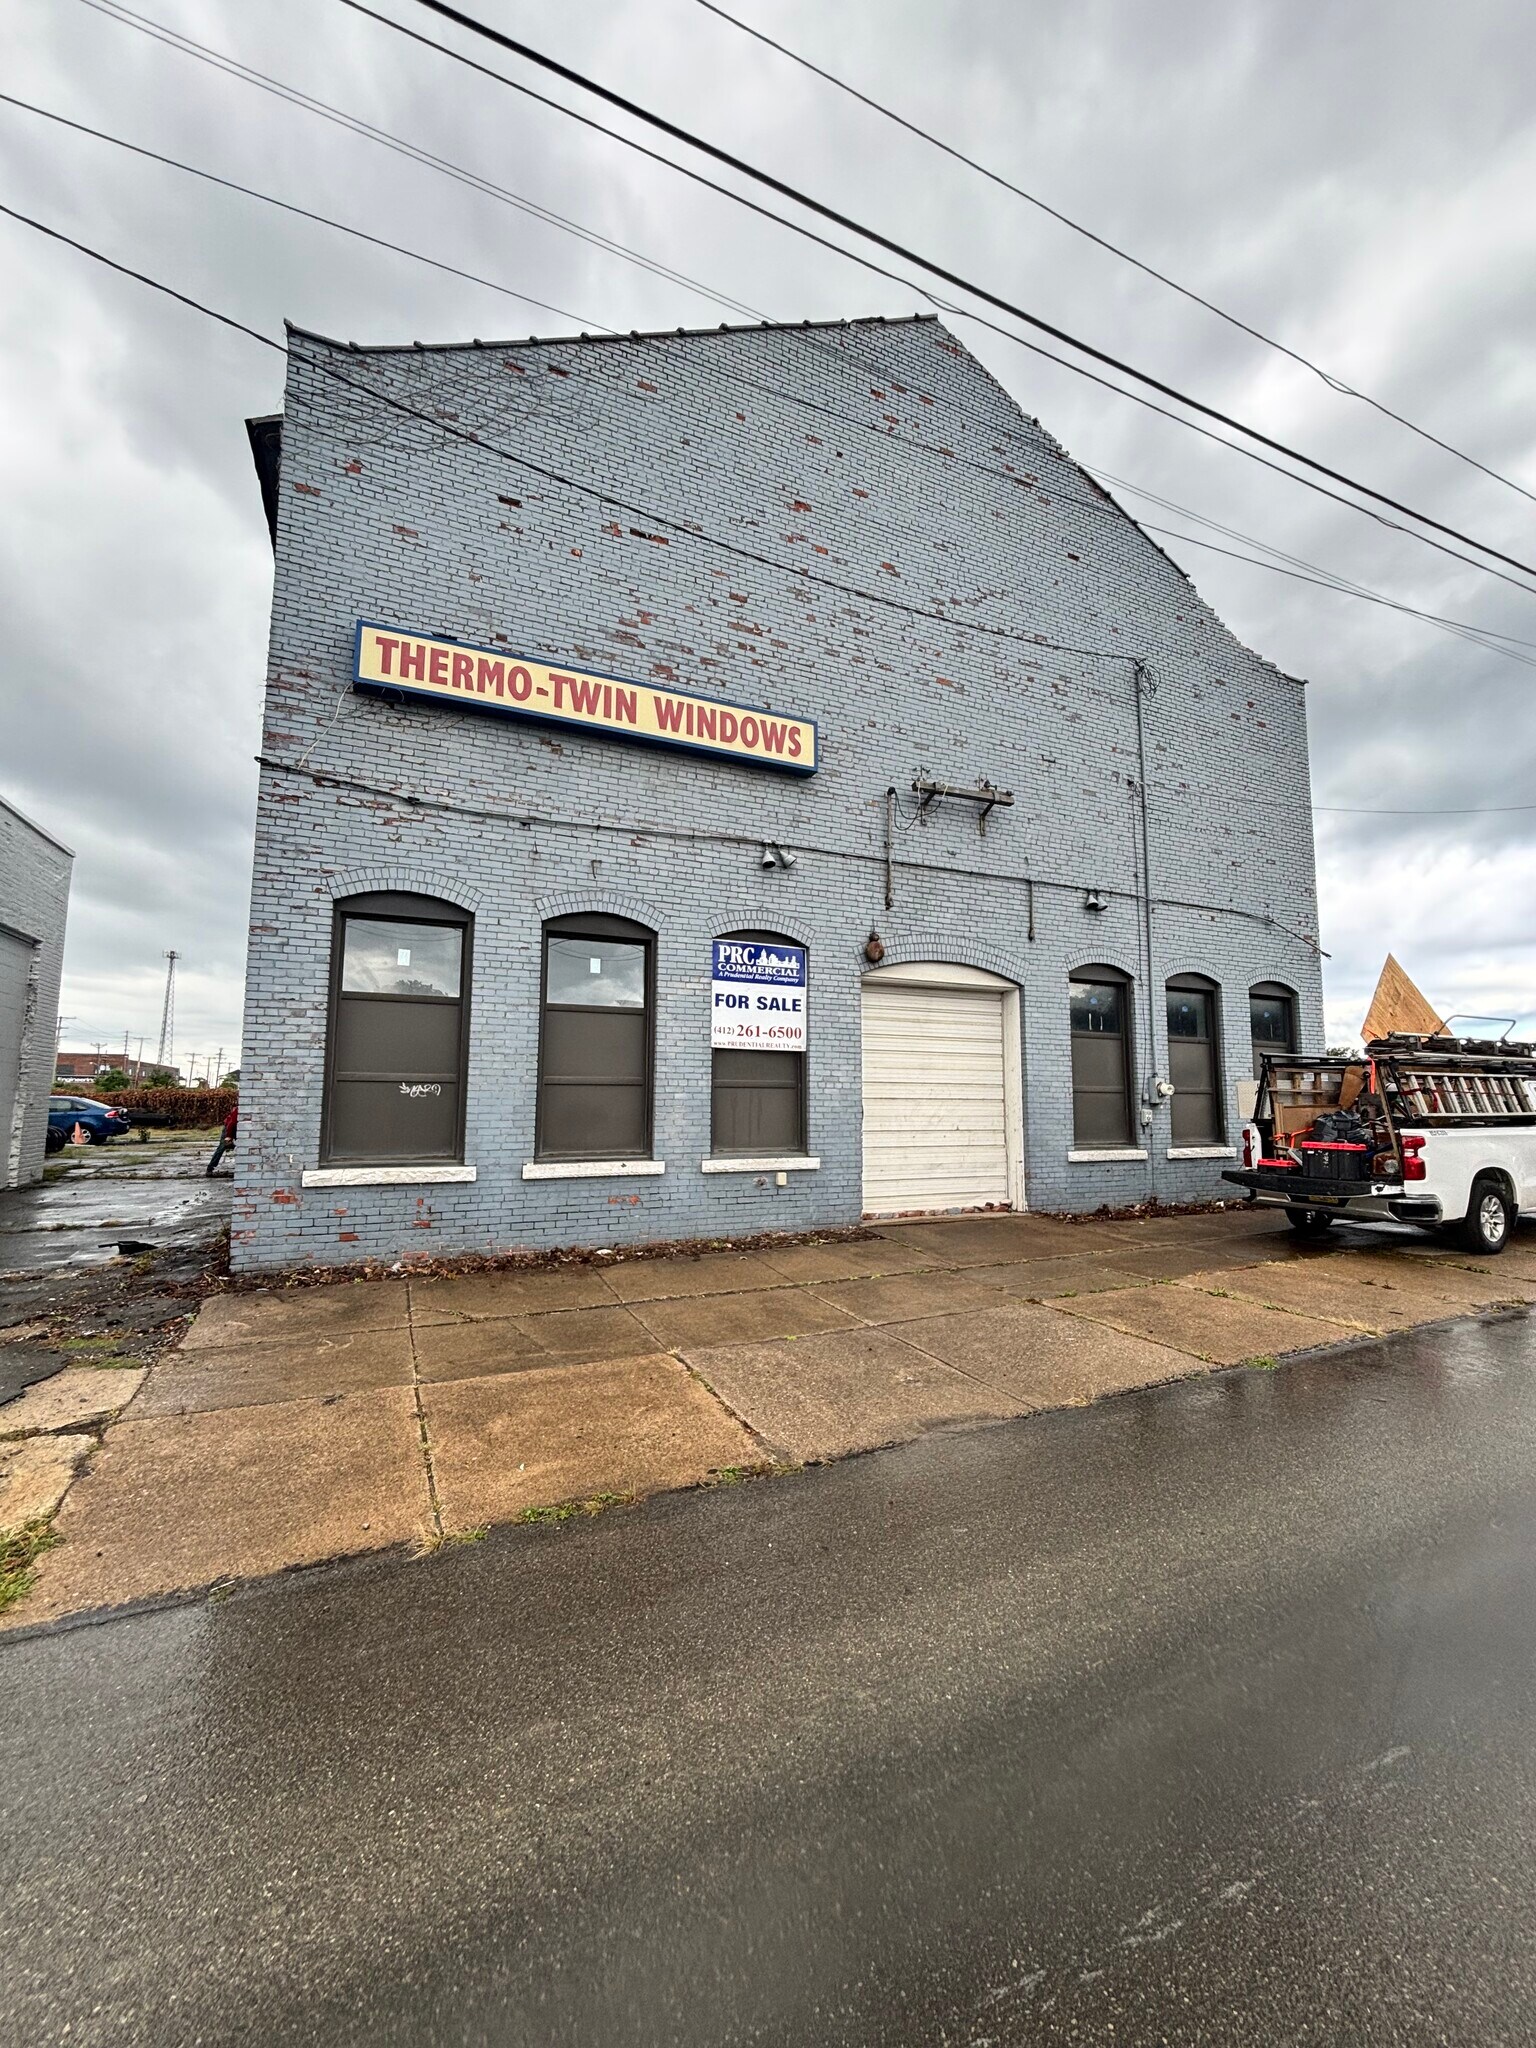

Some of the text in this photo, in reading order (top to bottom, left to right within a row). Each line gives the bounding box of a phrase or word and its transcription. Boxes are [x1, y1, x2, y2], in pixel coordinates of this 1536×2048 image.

[376, 636, 802, 757] THERMO-TWIN WINDOWS
[718, 944, 755, 965] PRC
[717, 962, 799, 977] COMMERCIAL
[715, 993, 802, 1012] FOR SALE
[713, 1024, 802, 1039] (412) 261-6500
